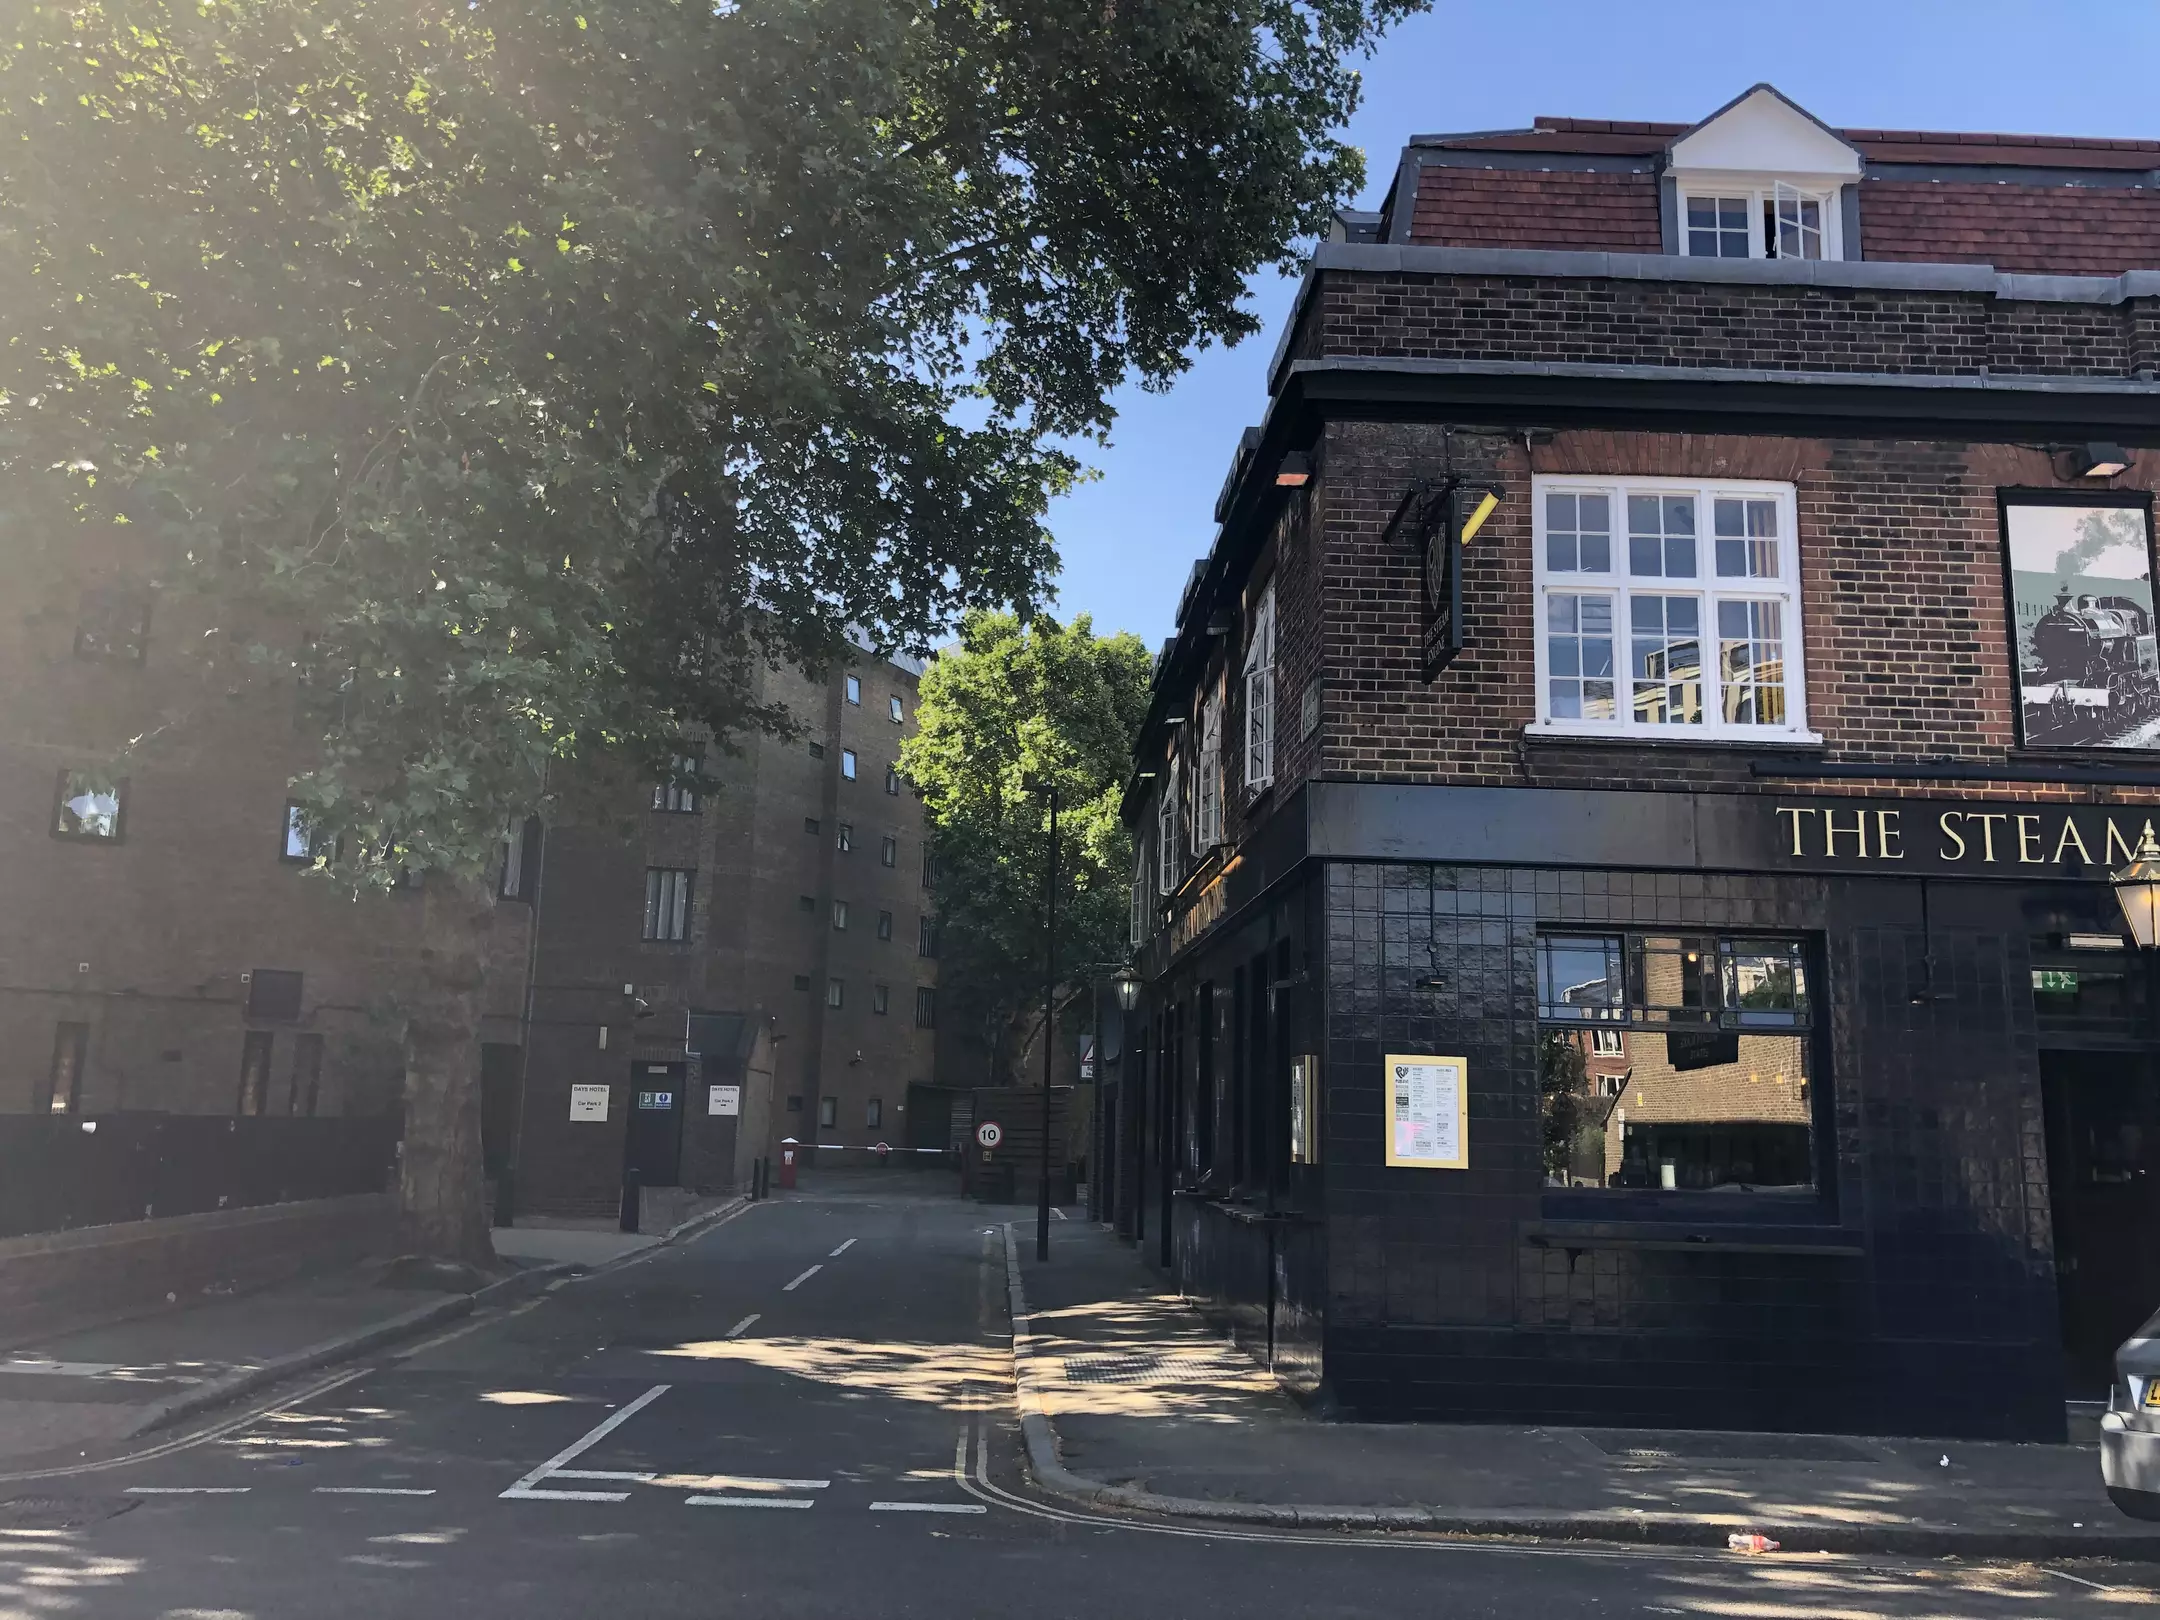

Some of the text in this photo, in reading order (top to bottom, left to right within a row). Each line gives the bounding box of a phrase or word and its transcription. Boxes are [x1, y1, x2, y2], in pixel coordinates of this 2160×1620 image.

[1775, 806, 2145, 866] THE STEAM
[982, 1129, 996, 1141] 10
